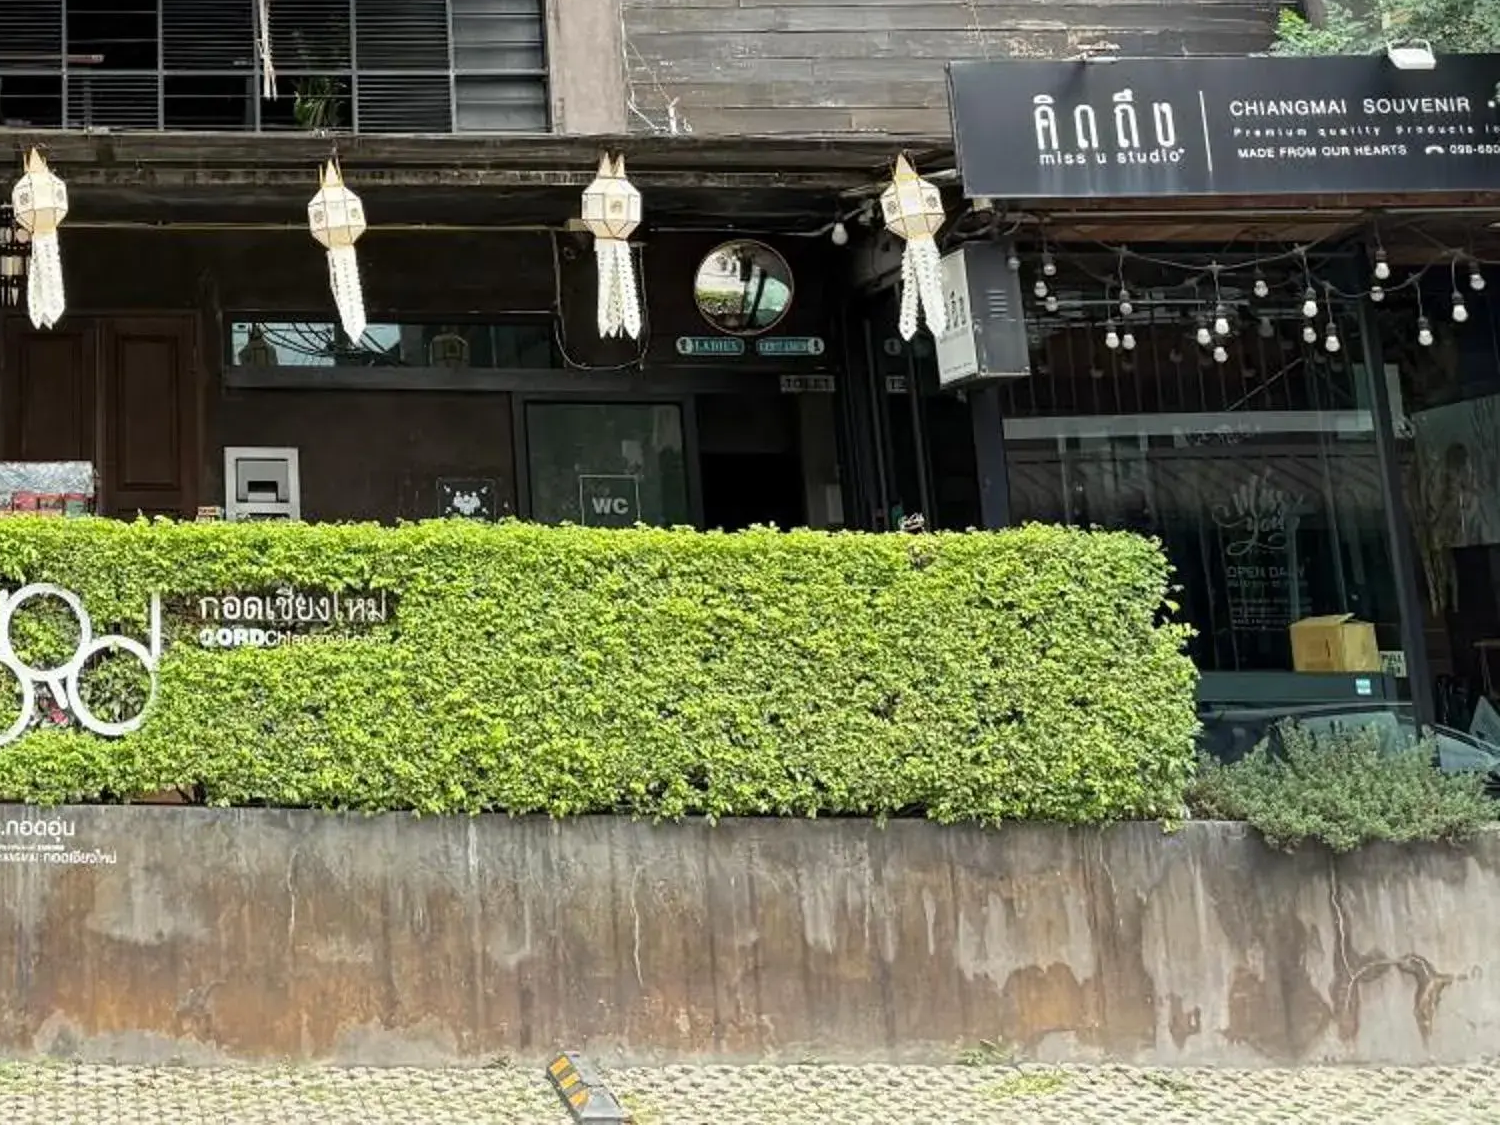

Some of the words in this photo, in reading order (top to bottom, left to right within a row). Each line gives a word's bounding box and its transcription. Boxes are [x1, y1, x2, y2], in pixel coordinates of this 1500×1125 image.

[1229, 99, 1348, 117] CHIANGMAI
[1363, 96, 1471, 115] SOUVENIR
[1039, 150, 1087, 166] miss
[1096, 152, 1107, 164] u
[1237, 147, 1275, 159] MADE
[1280, 146, 1317, 158] FROM
[1322, 146, 1350, 157] OUR
[1354, 145, 1408, 157] HEARTS
[591, 496, 629, 515] WC
